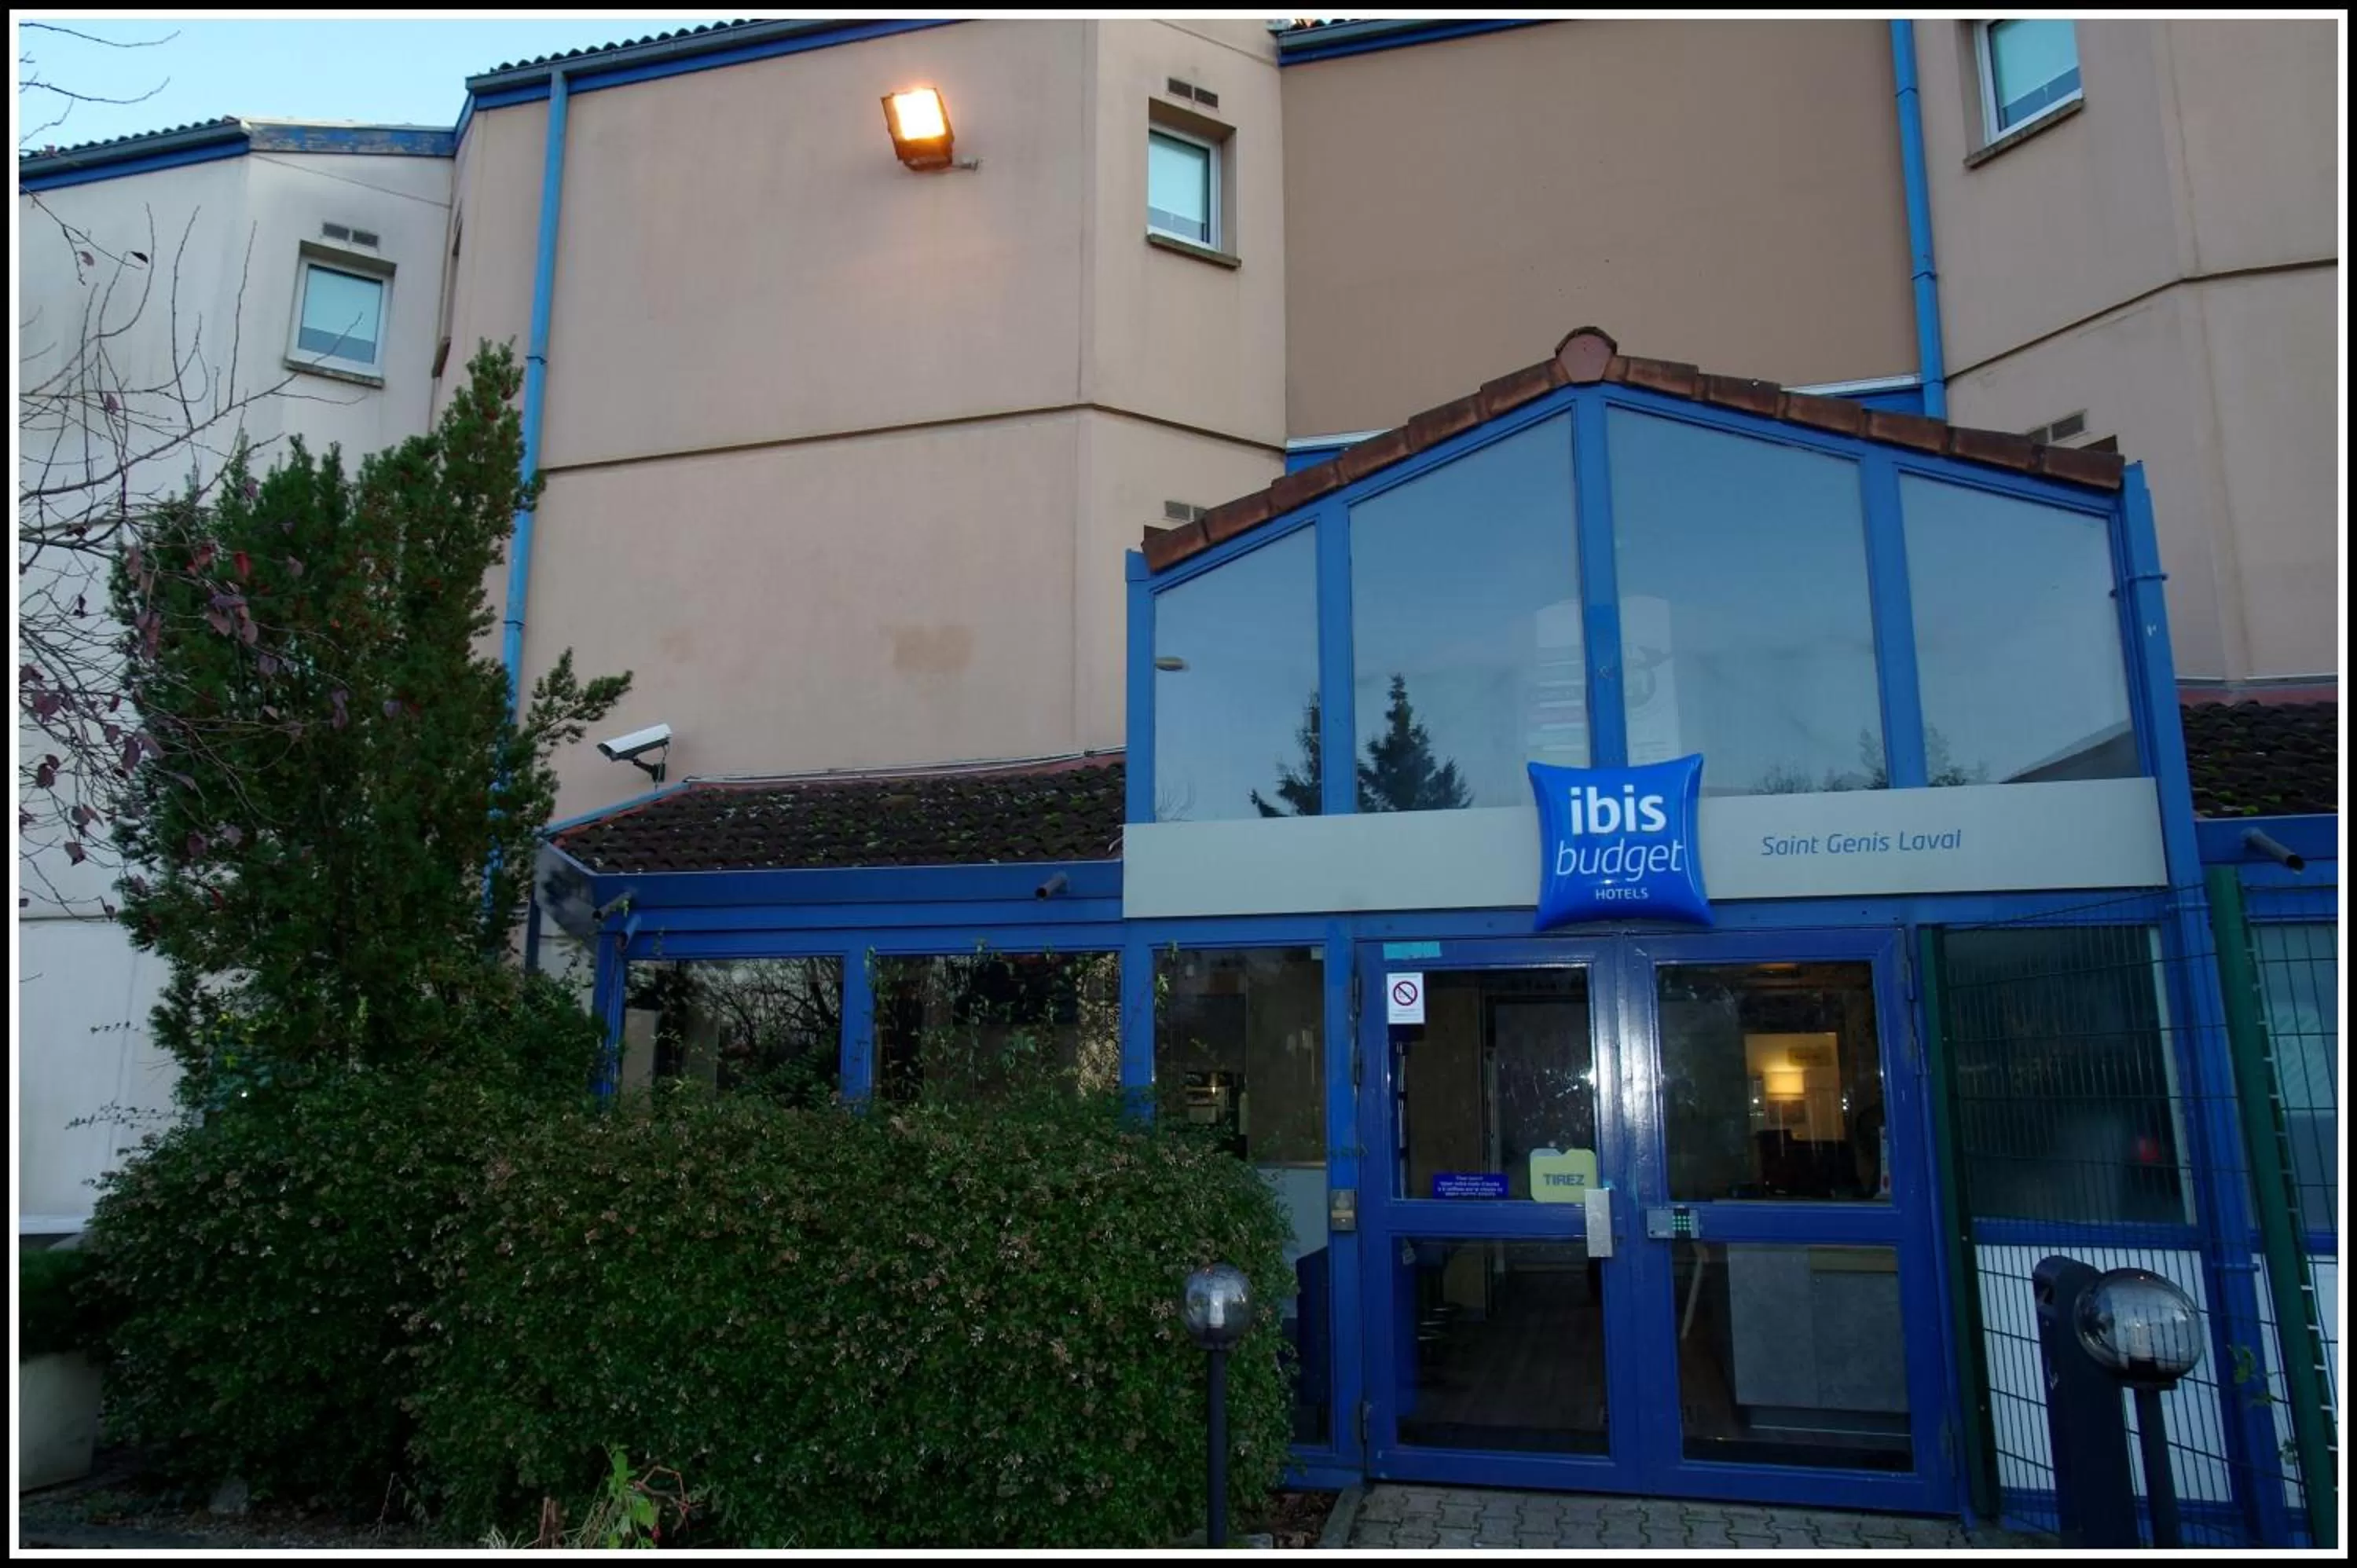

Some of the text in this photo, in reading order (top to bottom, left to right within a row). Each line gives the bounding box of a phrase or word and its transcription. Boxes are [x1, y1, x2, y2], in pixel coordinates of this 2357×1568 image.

[1571, 784, 1666, 835] ibis
[1761, 829, 1962, 856] Saint Genis Laval
[1556, 838, 1684, 882] budget
[1596, 888, 1649, 900] HOTELS
[1543, 1174, 1585, 1185] TIREZ
